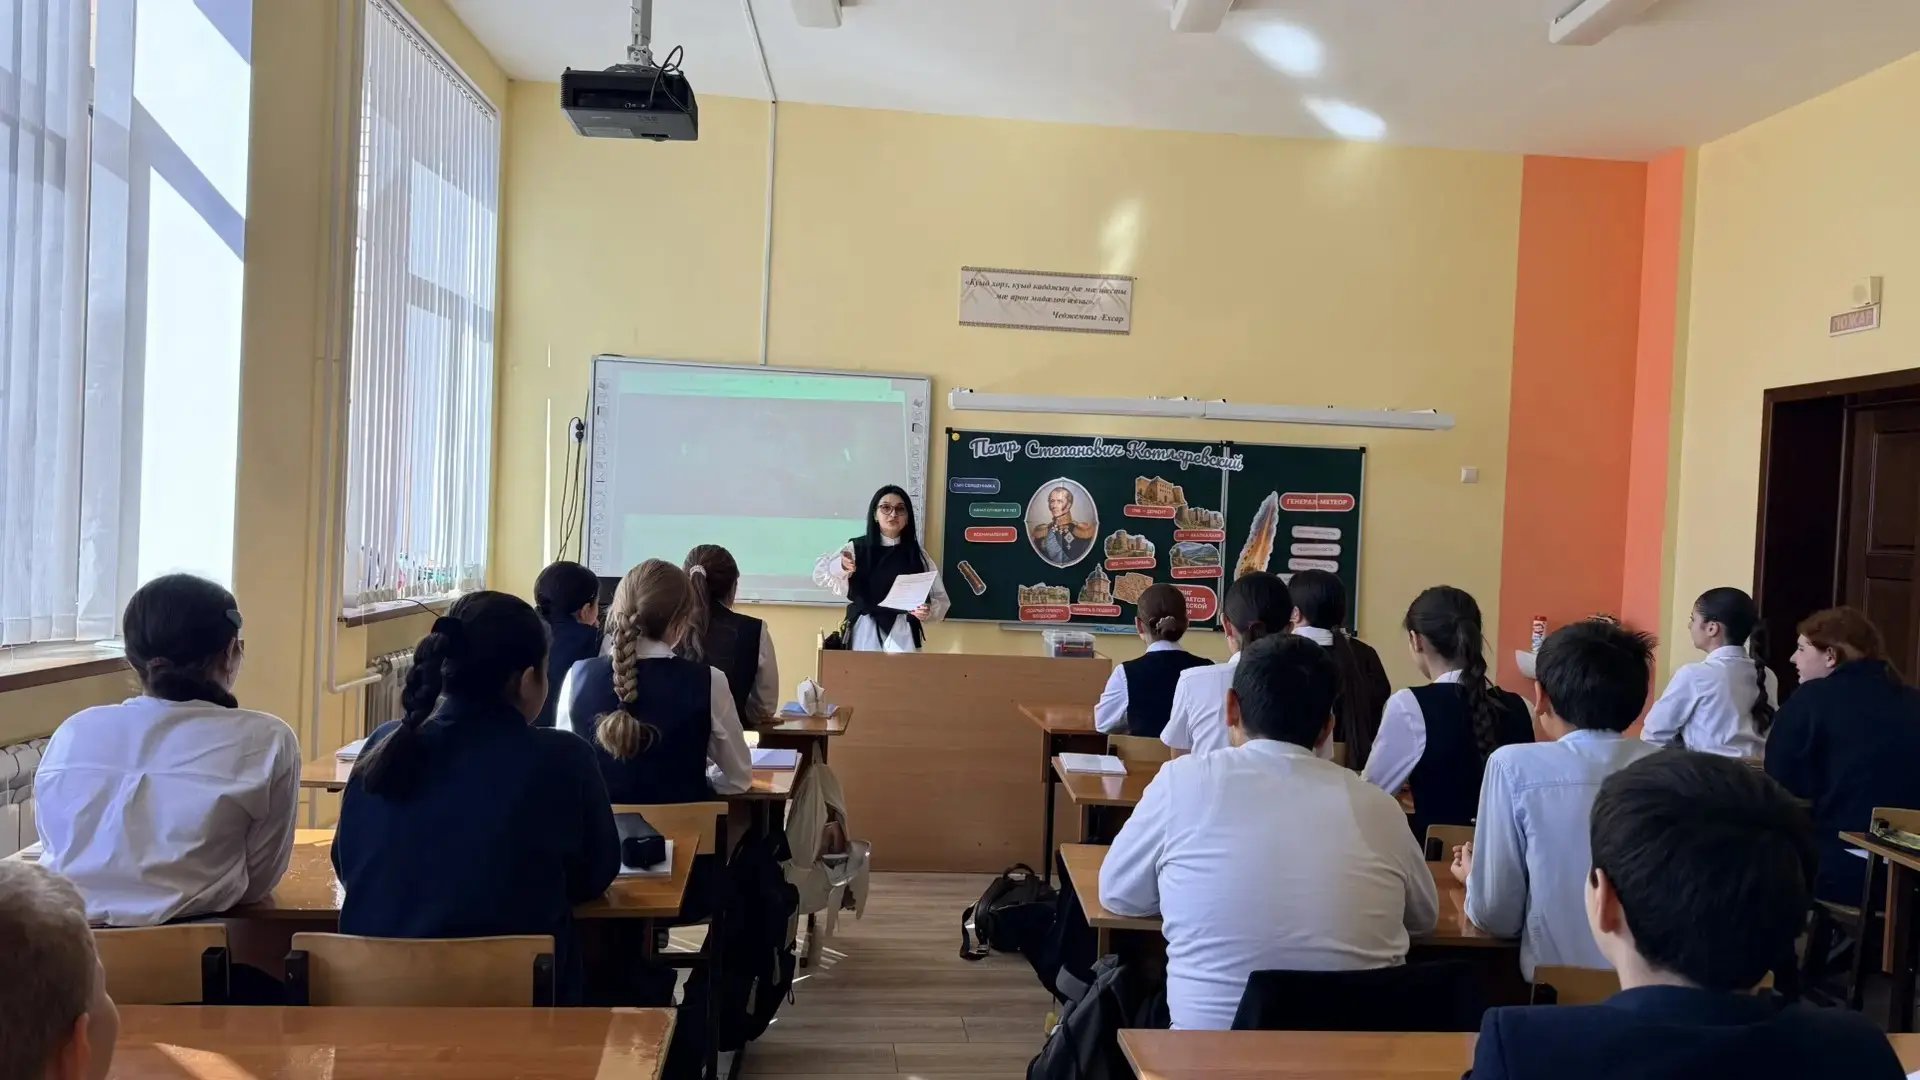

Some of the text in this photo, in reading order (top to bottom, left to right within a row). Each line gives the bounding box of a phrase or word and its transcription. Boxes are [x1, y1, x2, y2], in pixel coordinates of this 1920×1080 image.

[969, 437, 1244, 471] Петр Степанович Котляревский
[1286, 498, 1348, 506] ГЕНЕРАЛ-МЕТЕОР
